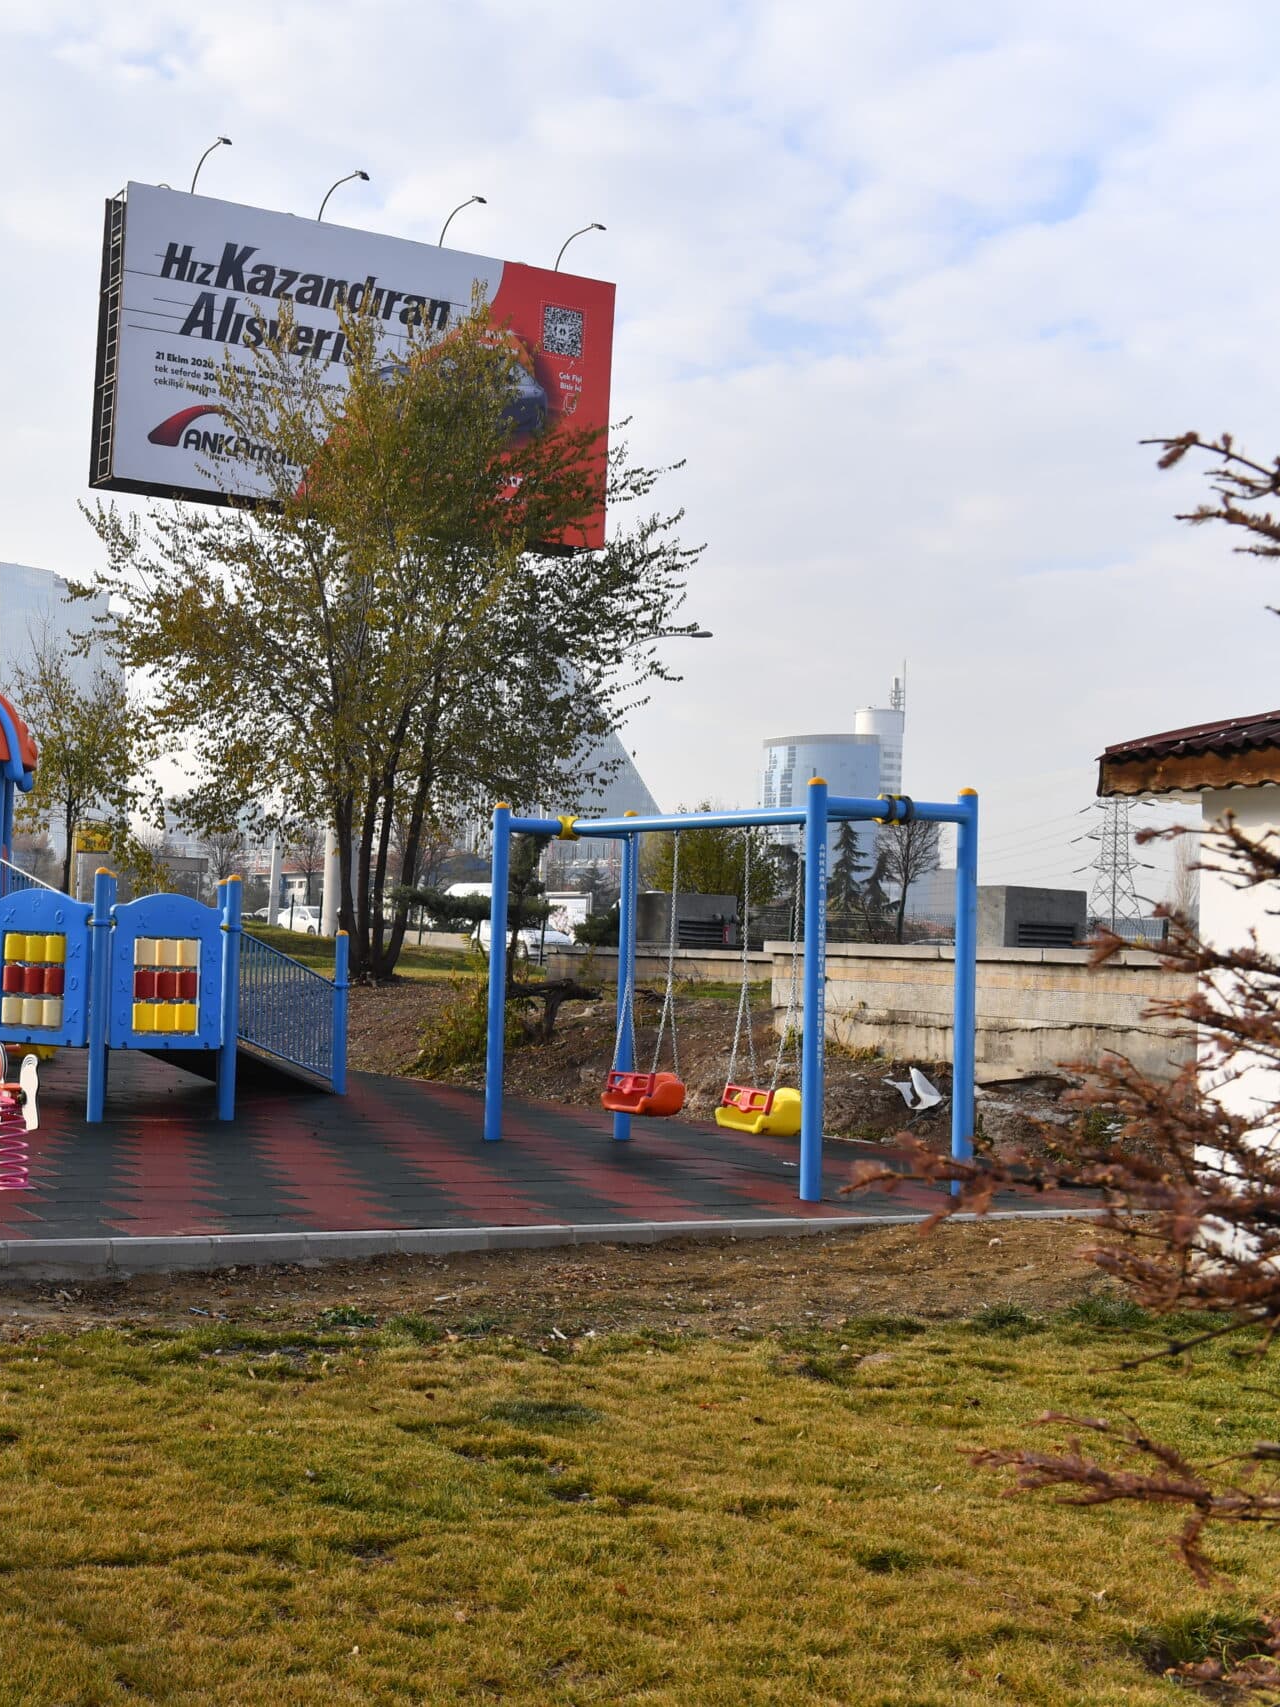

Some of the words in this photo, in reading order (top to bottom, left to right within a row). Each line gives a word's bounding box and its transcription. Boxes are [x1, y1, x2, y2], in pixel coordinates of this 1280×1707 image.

[155, 351, 165, 360] 21
[166, 353, 189, 365] Ekim
[154, 364, 169, 374] tek
[170, 367, 202, 379] seferde
[818, 843, 826, 891] ANKARA
